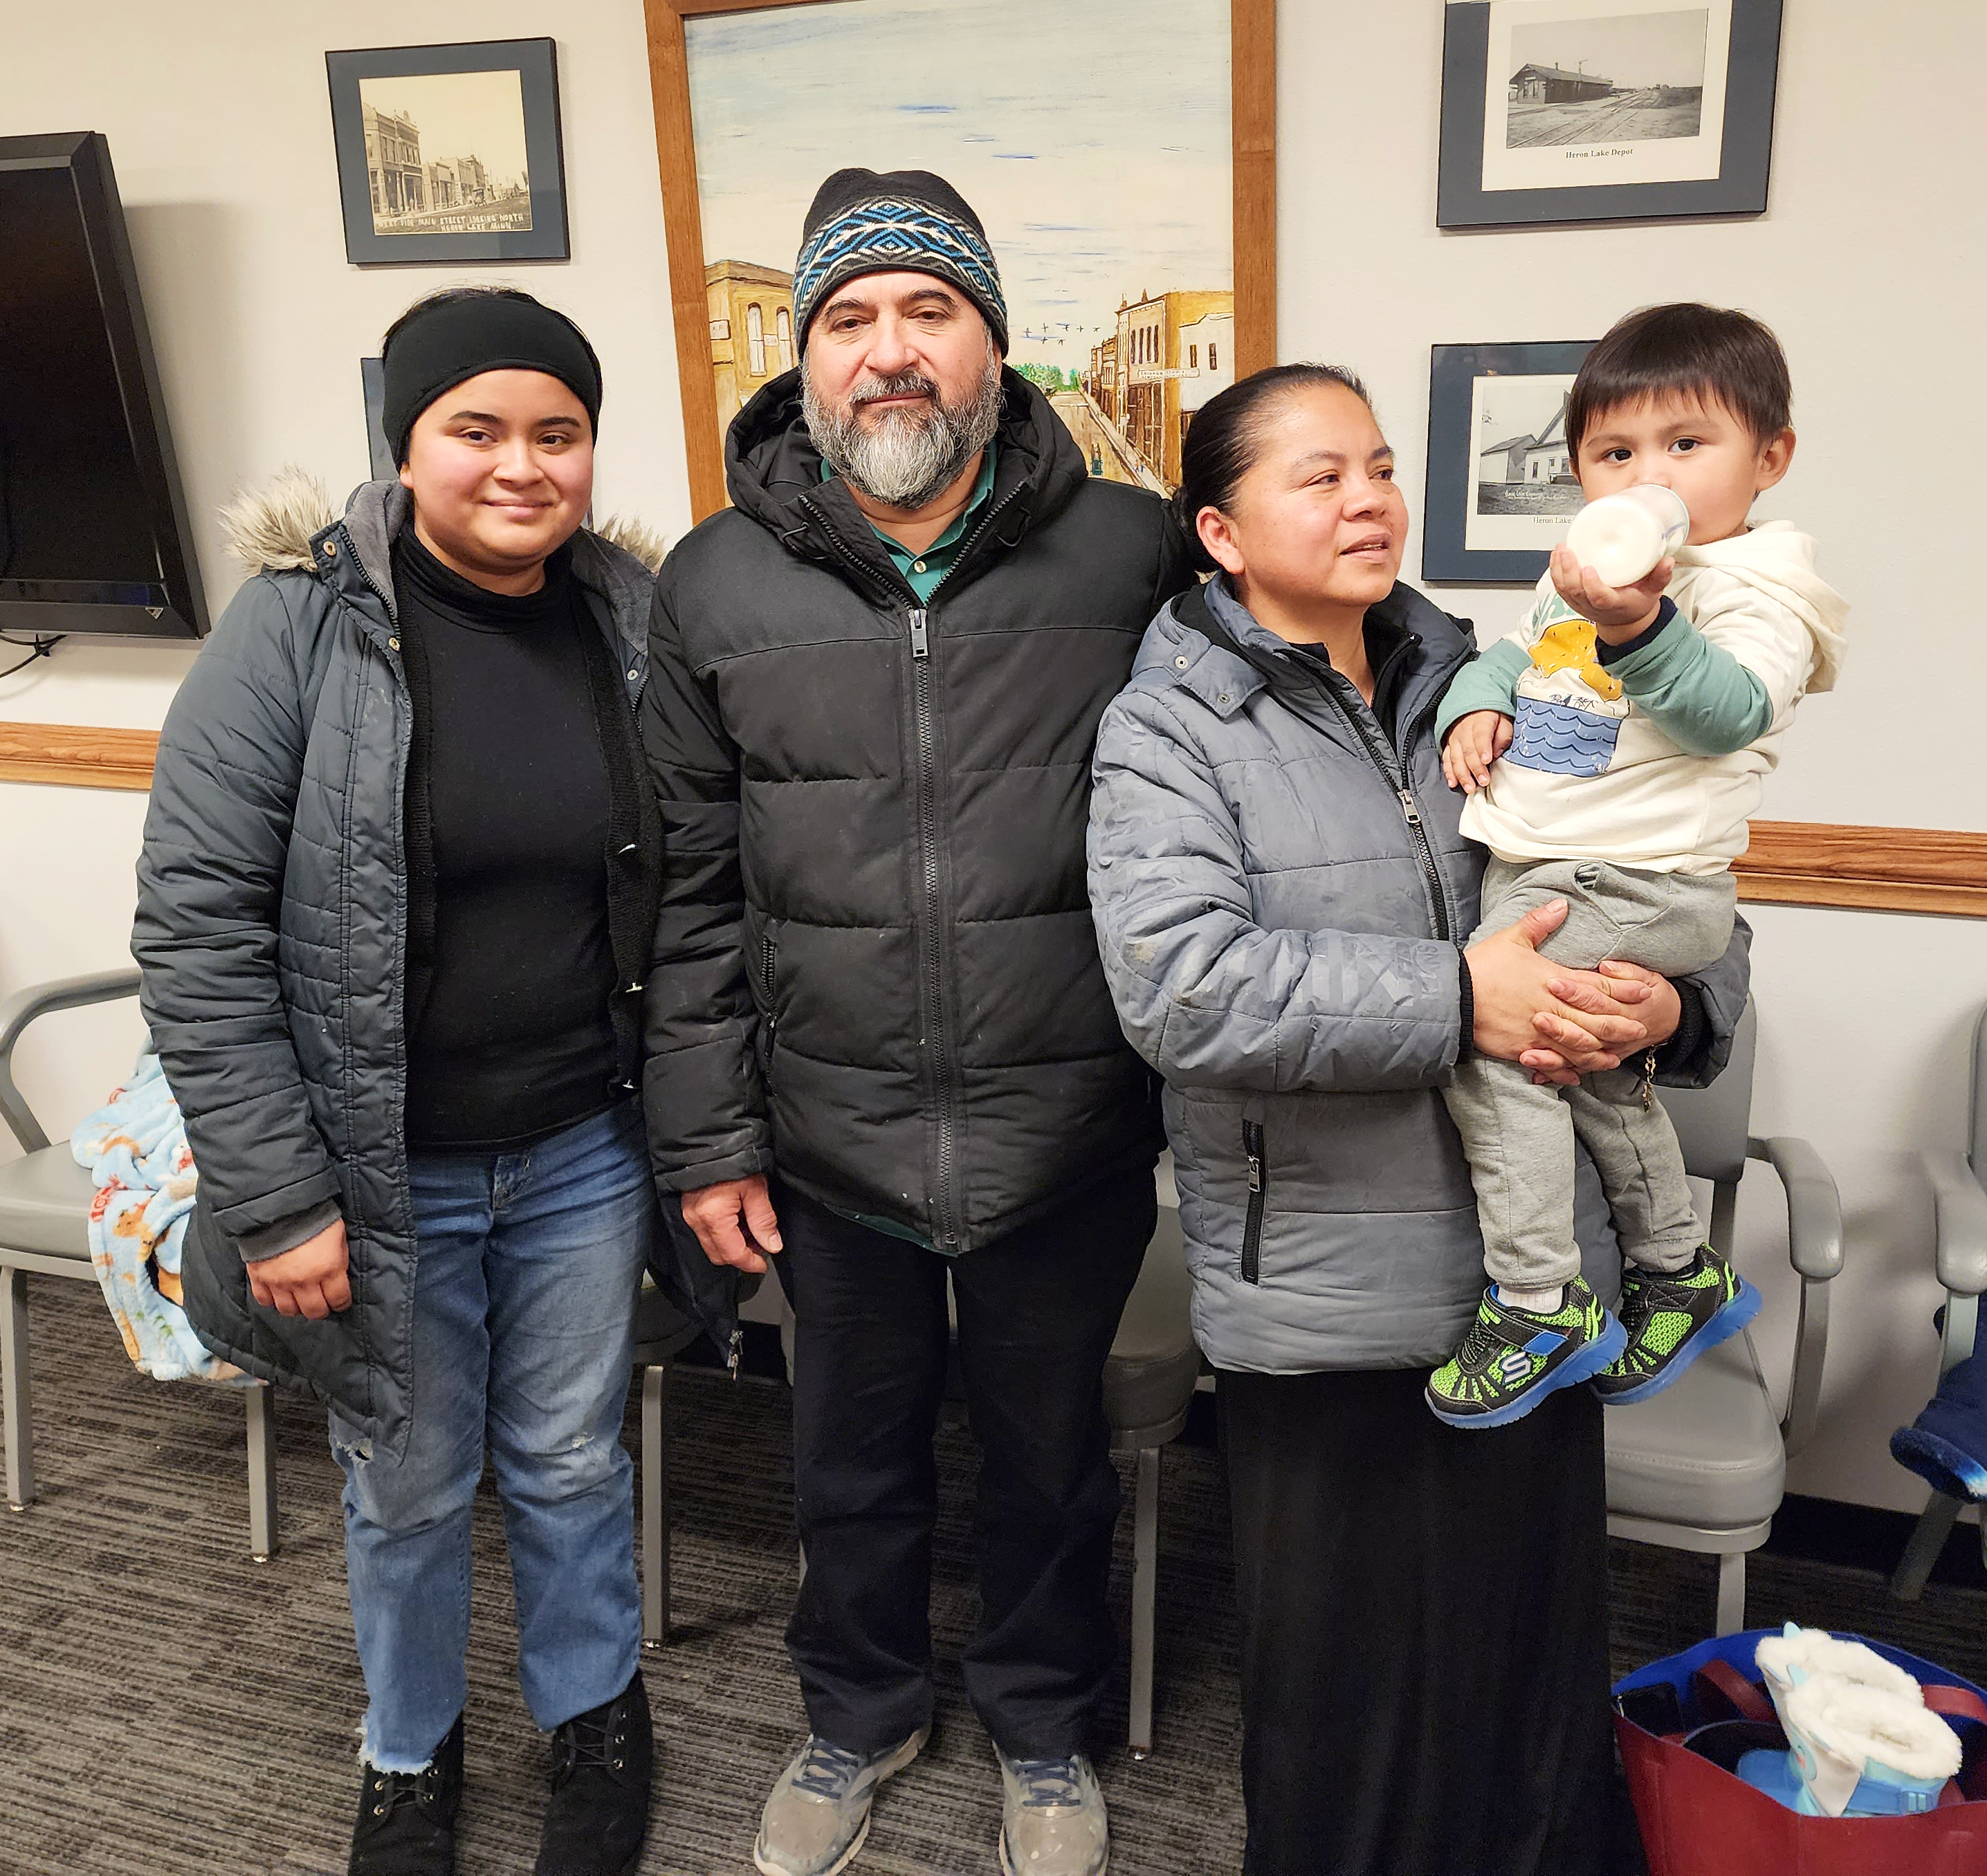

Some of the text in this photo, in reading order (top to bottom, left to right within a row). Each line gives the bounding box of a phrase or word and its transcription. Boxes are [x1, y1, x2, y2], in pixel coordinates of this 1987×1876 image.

[1611, 149, 1633, 157] Depot
[439, 215, 466, 225] STREET
[469, 214, 497, 223] LOOKING
[499, 213, 524, 222] NORTH
[466, 223, 486, 231] LAKE
